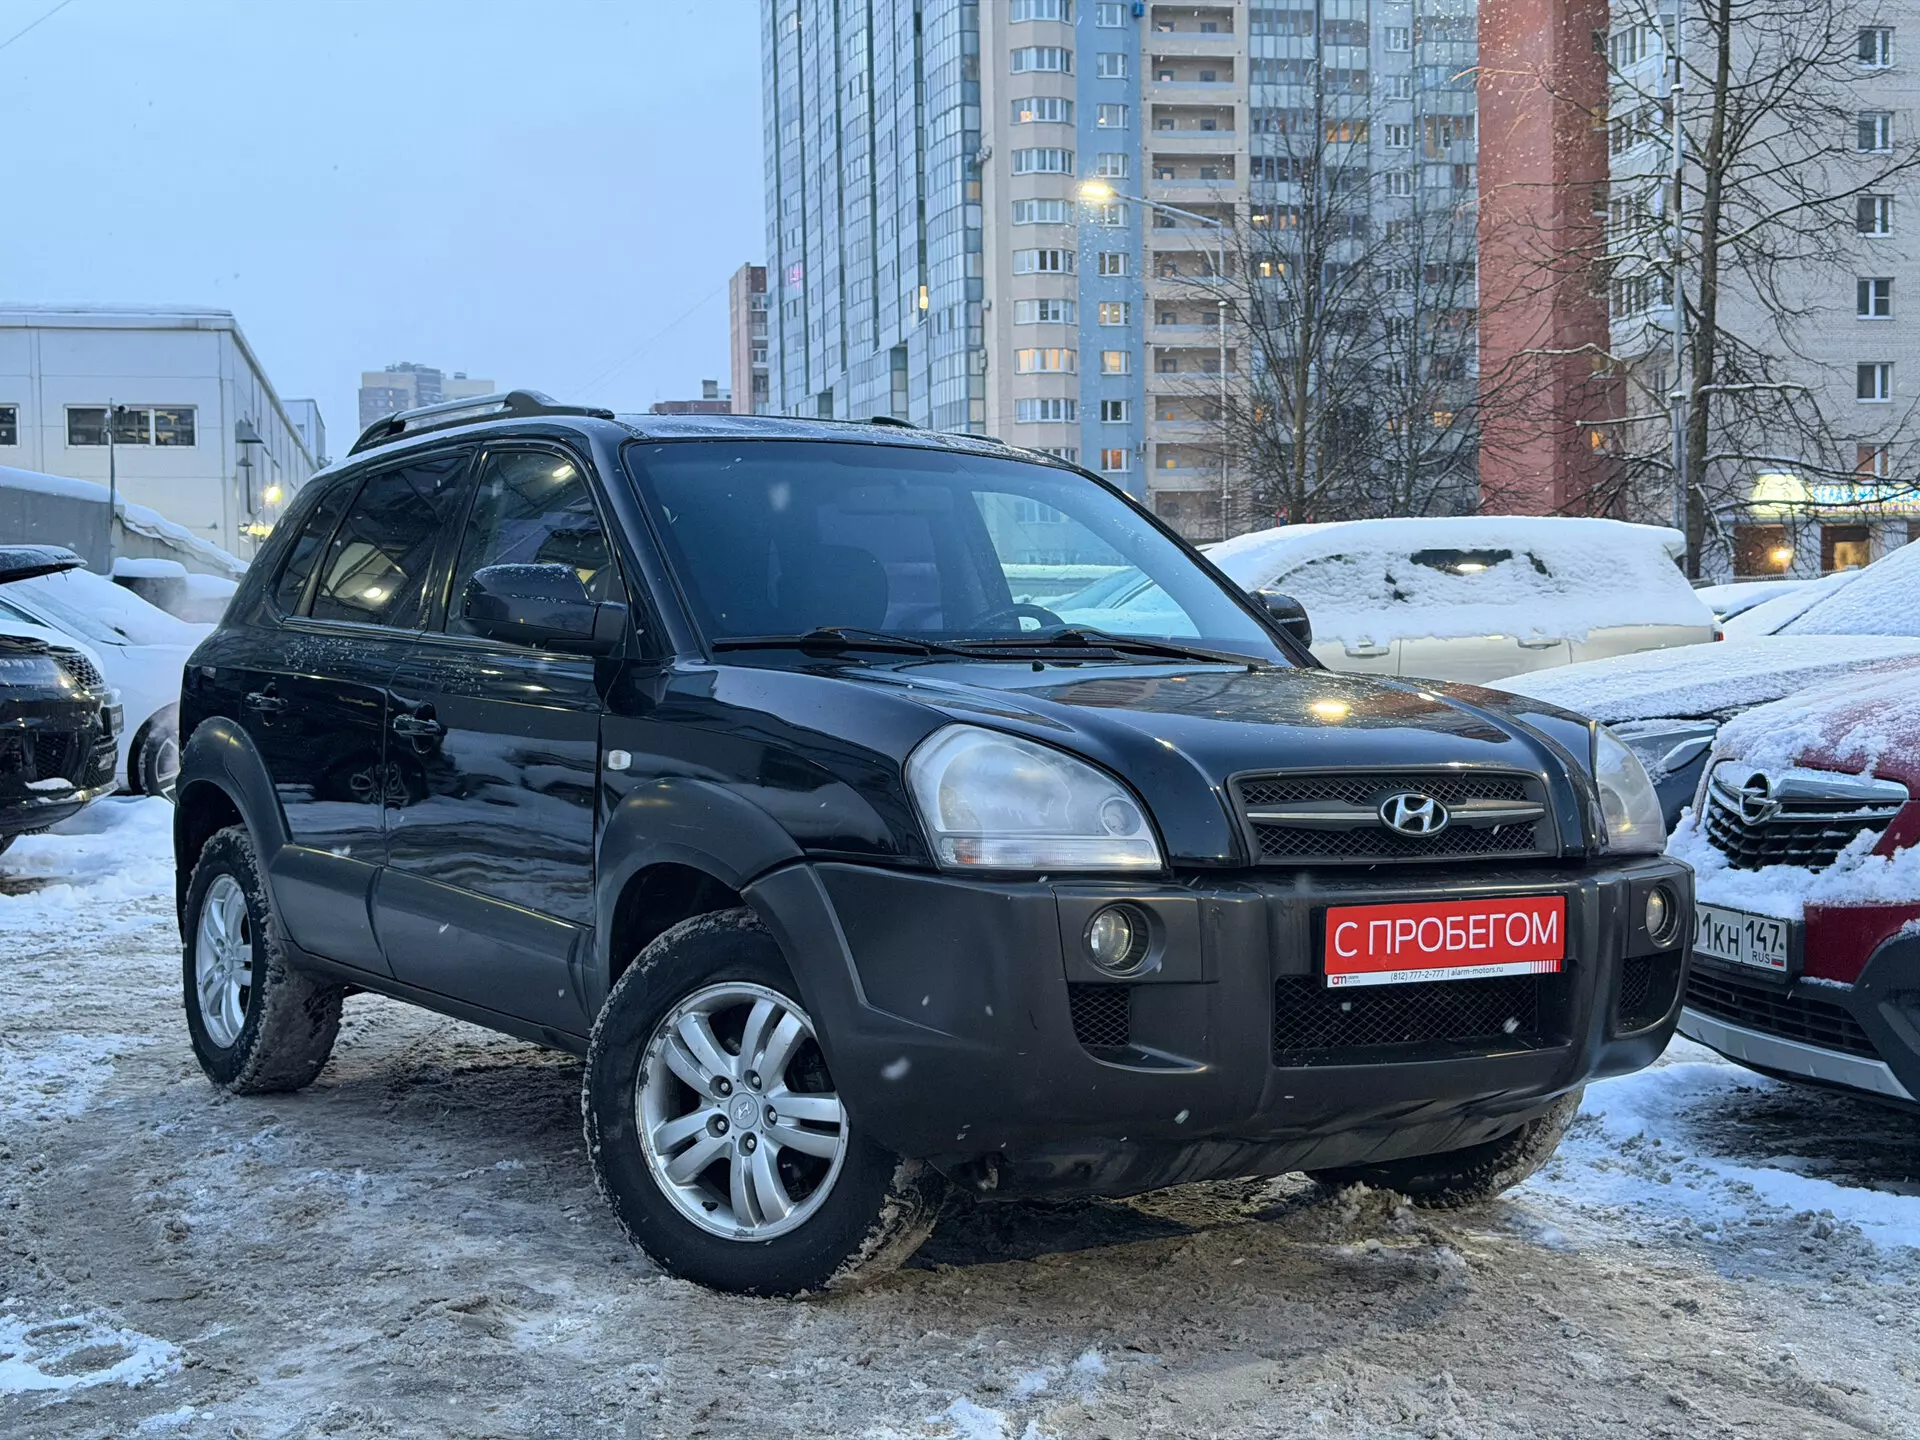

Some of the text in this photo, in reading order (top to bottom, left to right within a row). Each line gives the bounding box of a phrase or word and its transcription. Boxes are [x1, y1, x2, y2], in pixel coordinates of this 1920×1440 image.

[1334, 910, 1558, 957] С ПРОБЕГОМ
[1745, 920, 1780, 953] 147
[1751, 950, 1771, 964] RUS
[1390, 965, 1504, 981] (812) 777-2-777 alarm-motors.ru
